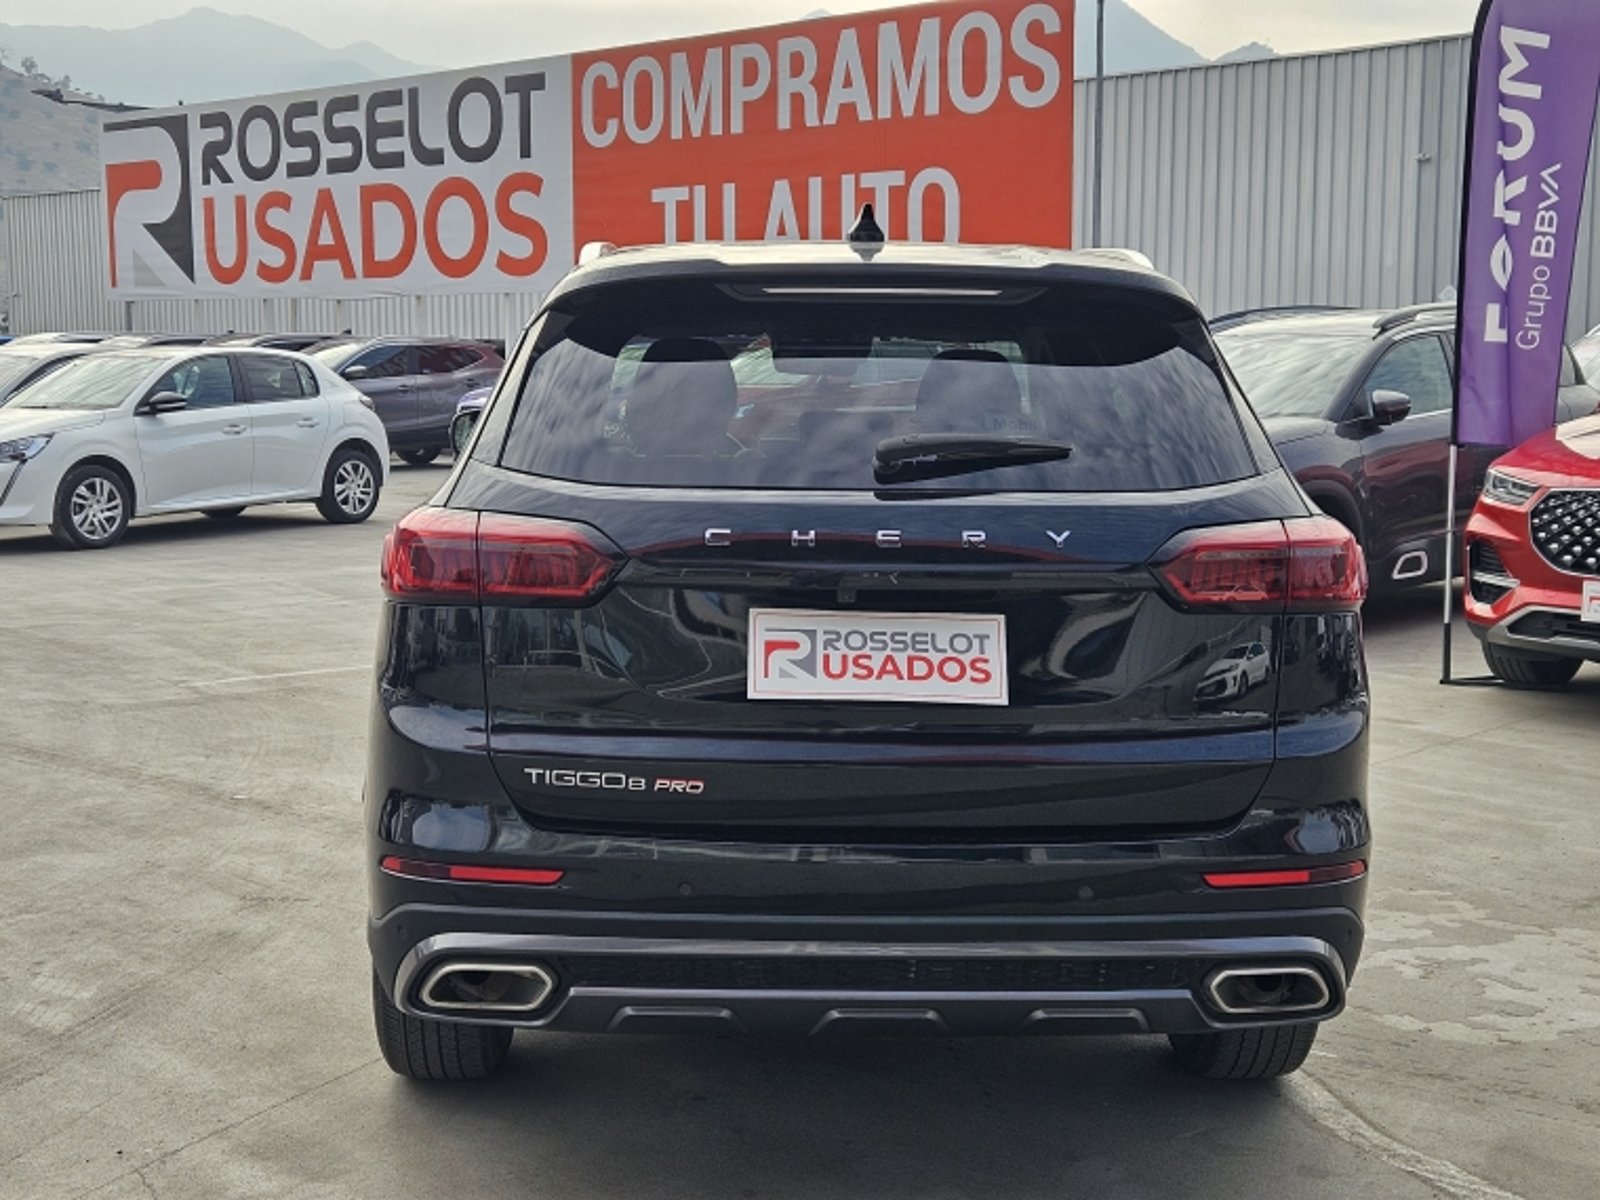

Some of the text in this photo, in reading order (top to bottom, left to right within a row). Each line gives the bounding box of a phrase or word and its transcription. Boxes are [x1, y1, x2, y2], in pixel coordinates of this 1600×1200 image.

[199, 71, 547, 185] ROSSELOT
[581, 3, 1062, 148] COMPRAMOS
[202, 171, 549, 285] USADOS
[1484, 25, 1551, 344] FORUM
[1515, 162, 1562, 350] Grupo BBVA
[704, 527, 1071, 549] CHERY
[822, 629, 991, 655] ROSSELOT
[822, 653, 993, 684] USADOS
[653, 777, 705, 795] PRO
